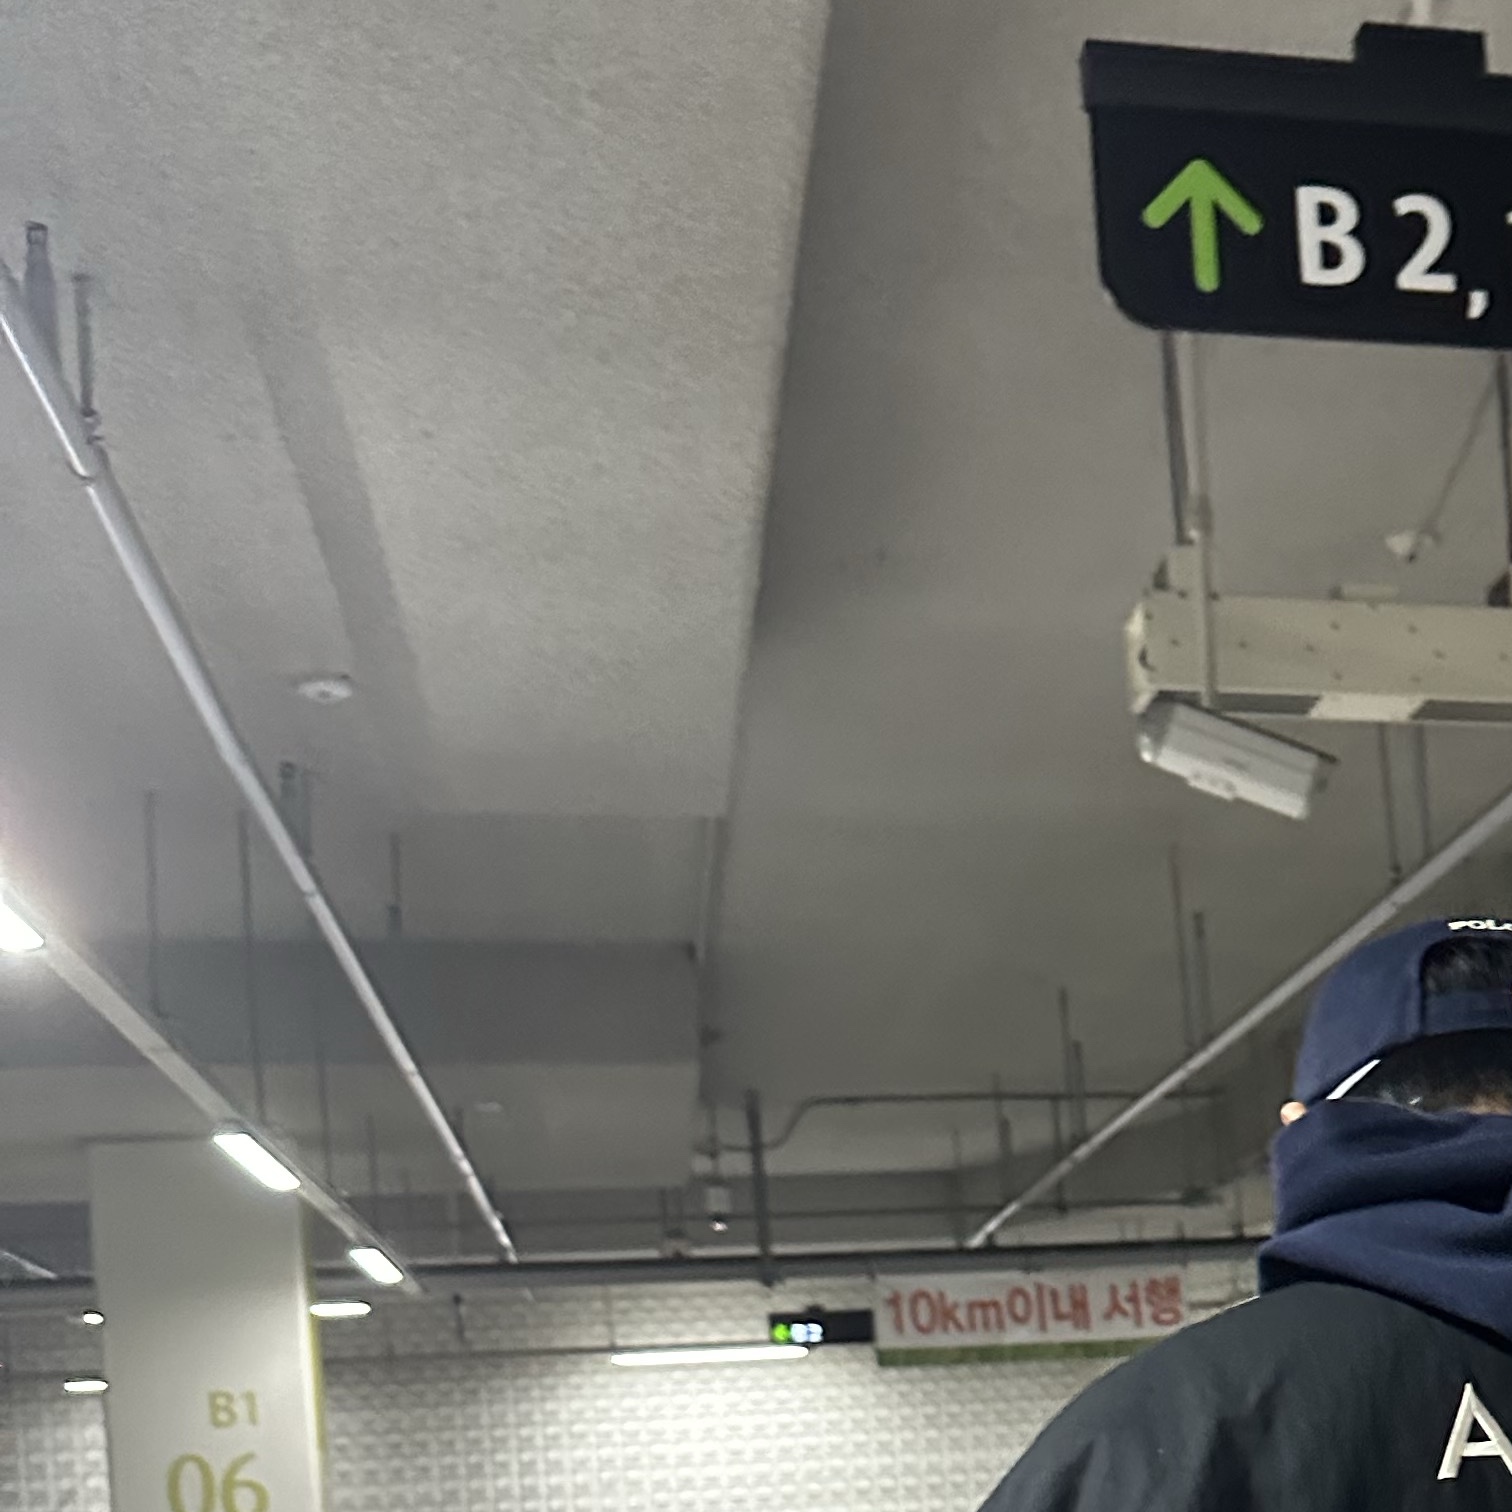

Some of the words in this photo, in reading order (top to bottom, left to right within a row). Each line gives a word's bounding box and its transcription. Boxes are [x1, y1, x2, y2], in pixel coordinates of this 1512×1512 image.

[885, 1281, 1094, 1334] 10km이내
[1103, 1271, 1185, 1328] 서행
[208, 1388, 260, 1429] B1
